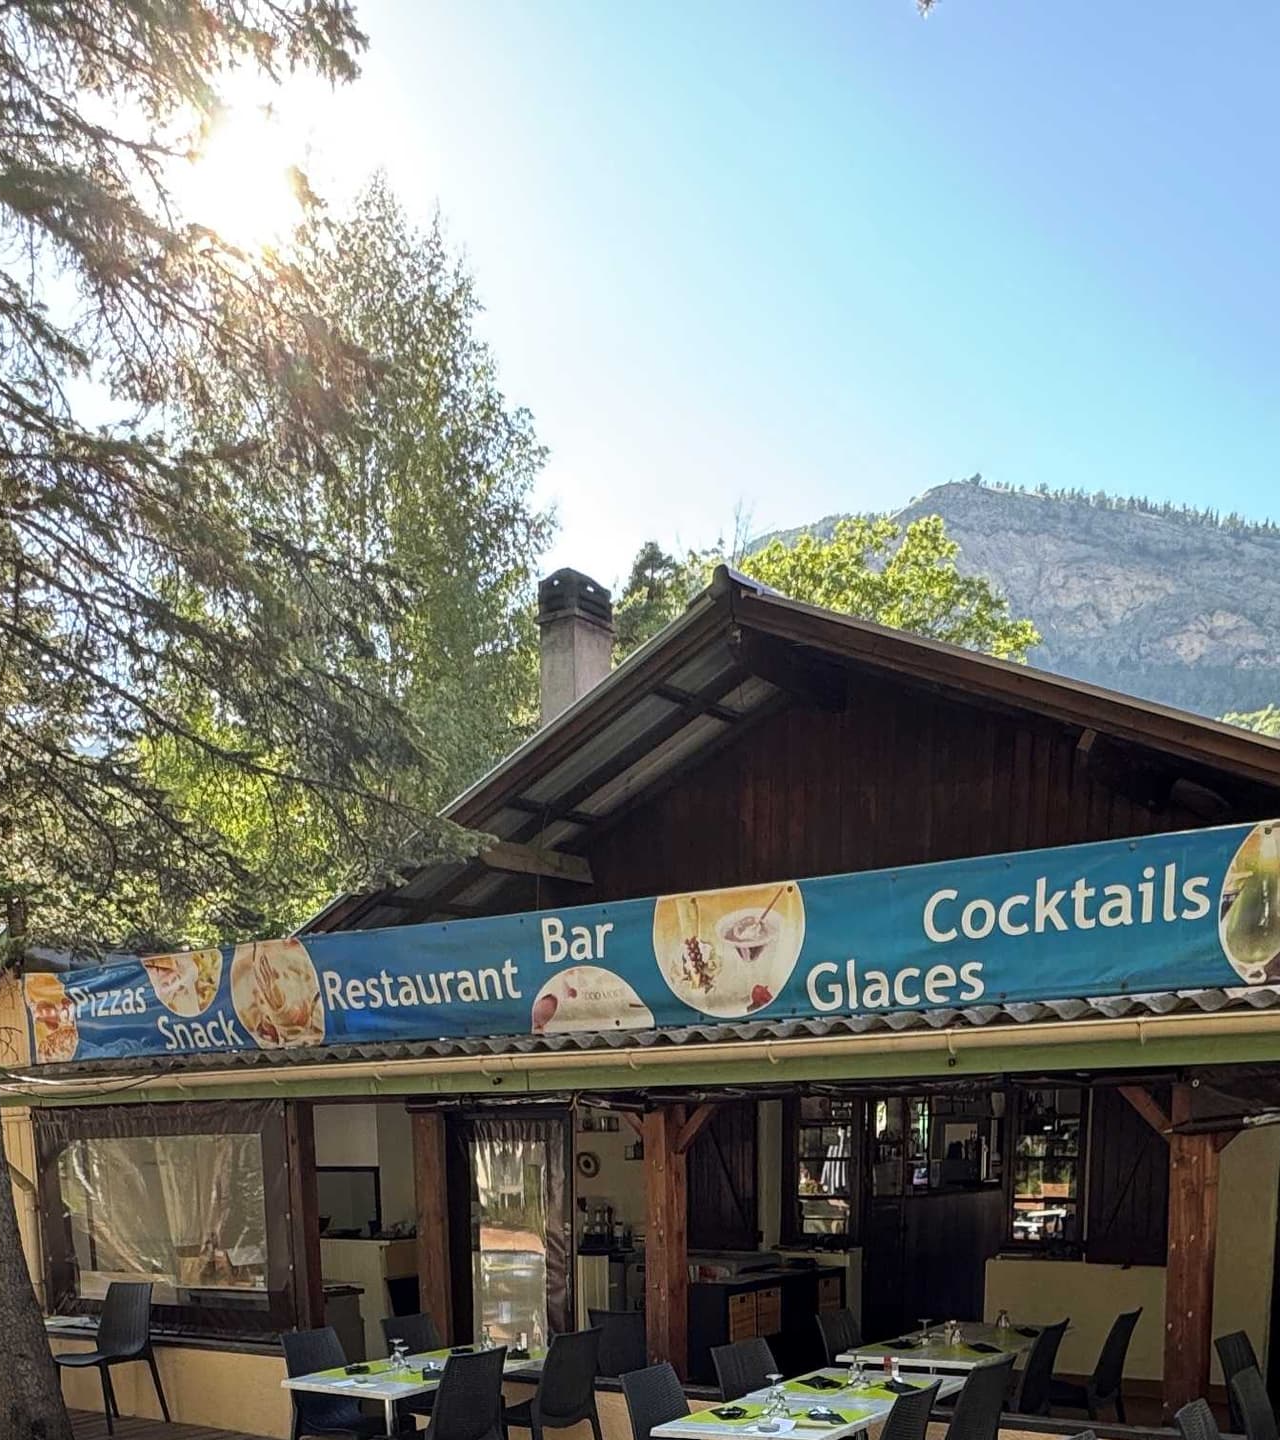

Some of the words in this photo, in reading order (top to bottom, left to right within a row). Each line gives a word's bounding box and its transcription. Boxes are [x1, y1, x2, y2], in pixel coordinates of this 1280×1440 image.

[923, 862, 1211, 943] Cocktails
[541, 917, 614, 964] Bar
[69, 986, 147, 1019] Pizzas
[322, 958, 522, 1011] Restaurant
[805, 958, 985, 1012] Glaces
[157, 1010, 244, 1050] Snack
